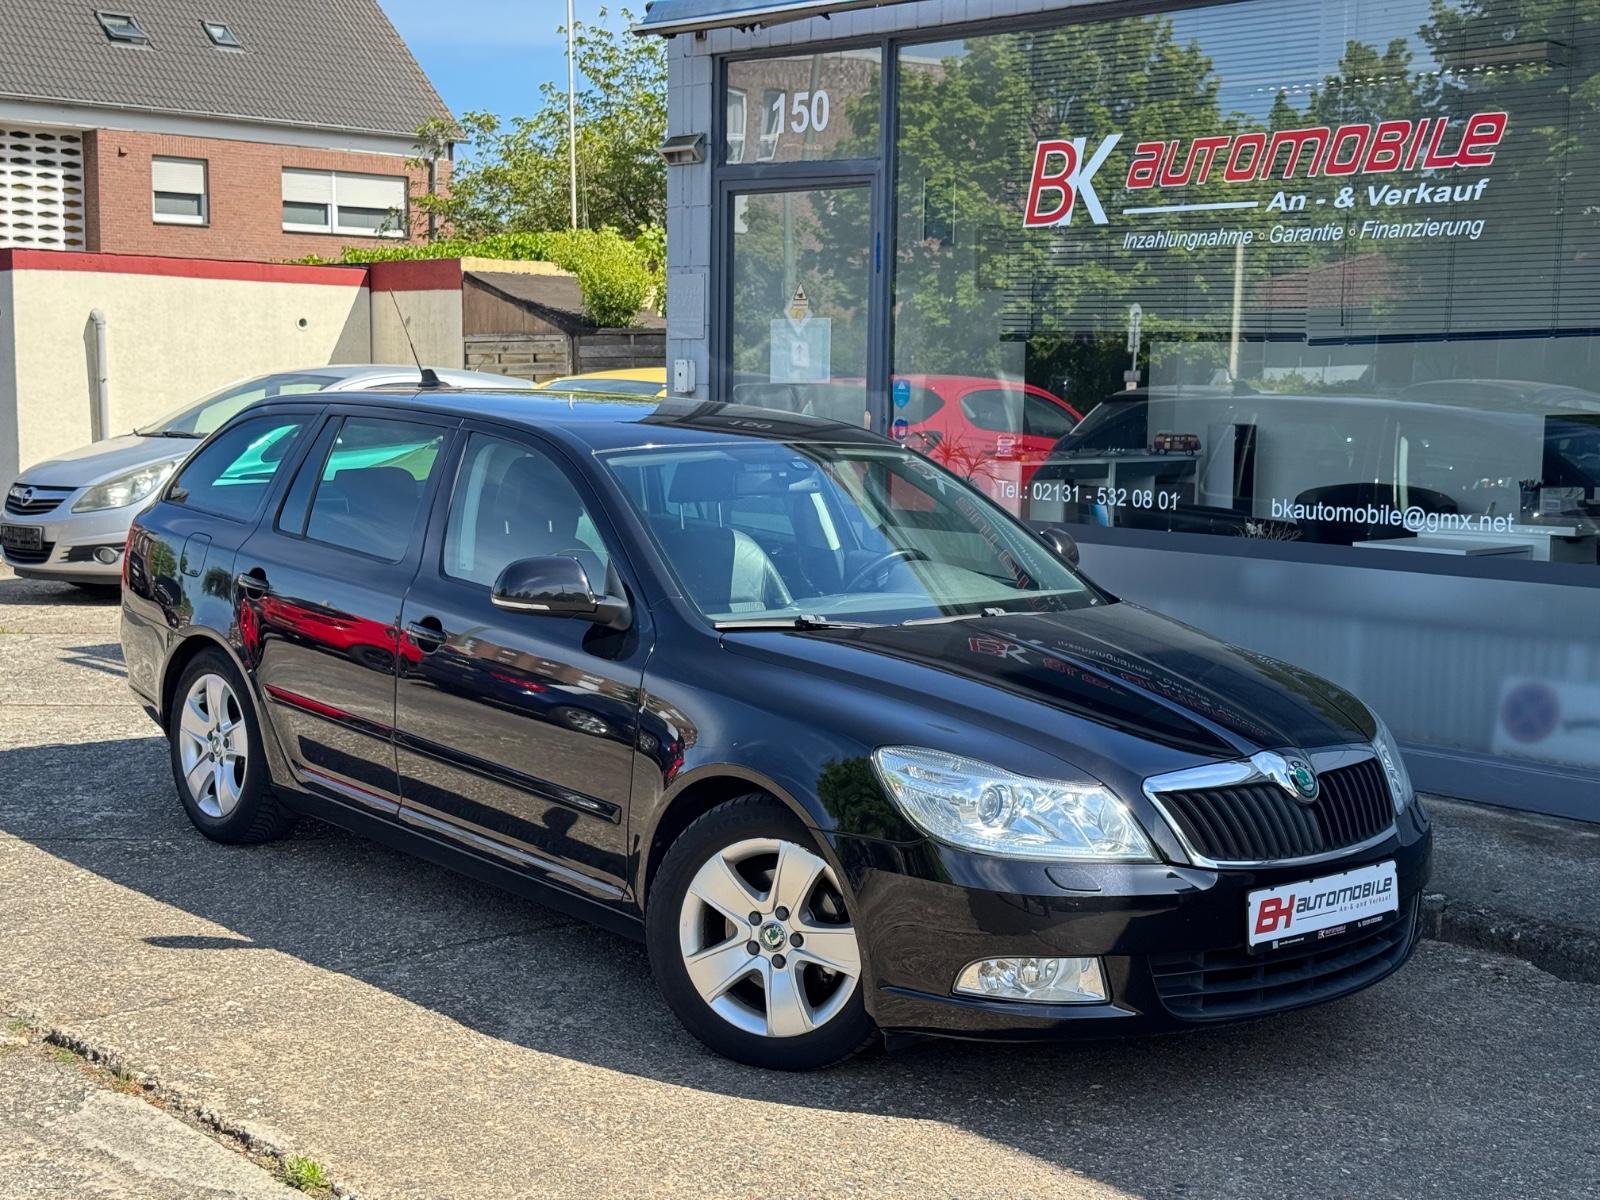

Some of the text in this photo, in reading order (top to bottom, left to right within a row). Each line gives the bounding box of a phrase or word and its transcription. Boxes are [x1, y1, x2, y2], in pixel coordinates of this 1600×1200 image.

[772, 89, 830, 134] 150
[1023, 133, 1123, 228] BK
[1265, 191, 1306, 212] An
[1333, 186, 1356, 208] &
[1367, 178, 1490, 207] Verkauf
[1123, 218, 1486, 251] Inzahlungnahme Garantie Finanzierung
[998, 480, 1028, 500] Tel.:
[1032, 482, 1080, 503] 02131
[1096, 487, 1127, 507] 532
[1132, 489, 1153, 509] 08
[1158, 491, 1178, 511] 01
[1271, 498, 1515, 533] bkautomobile@gmx.net
[1255, 895, 1295, 934] BK
